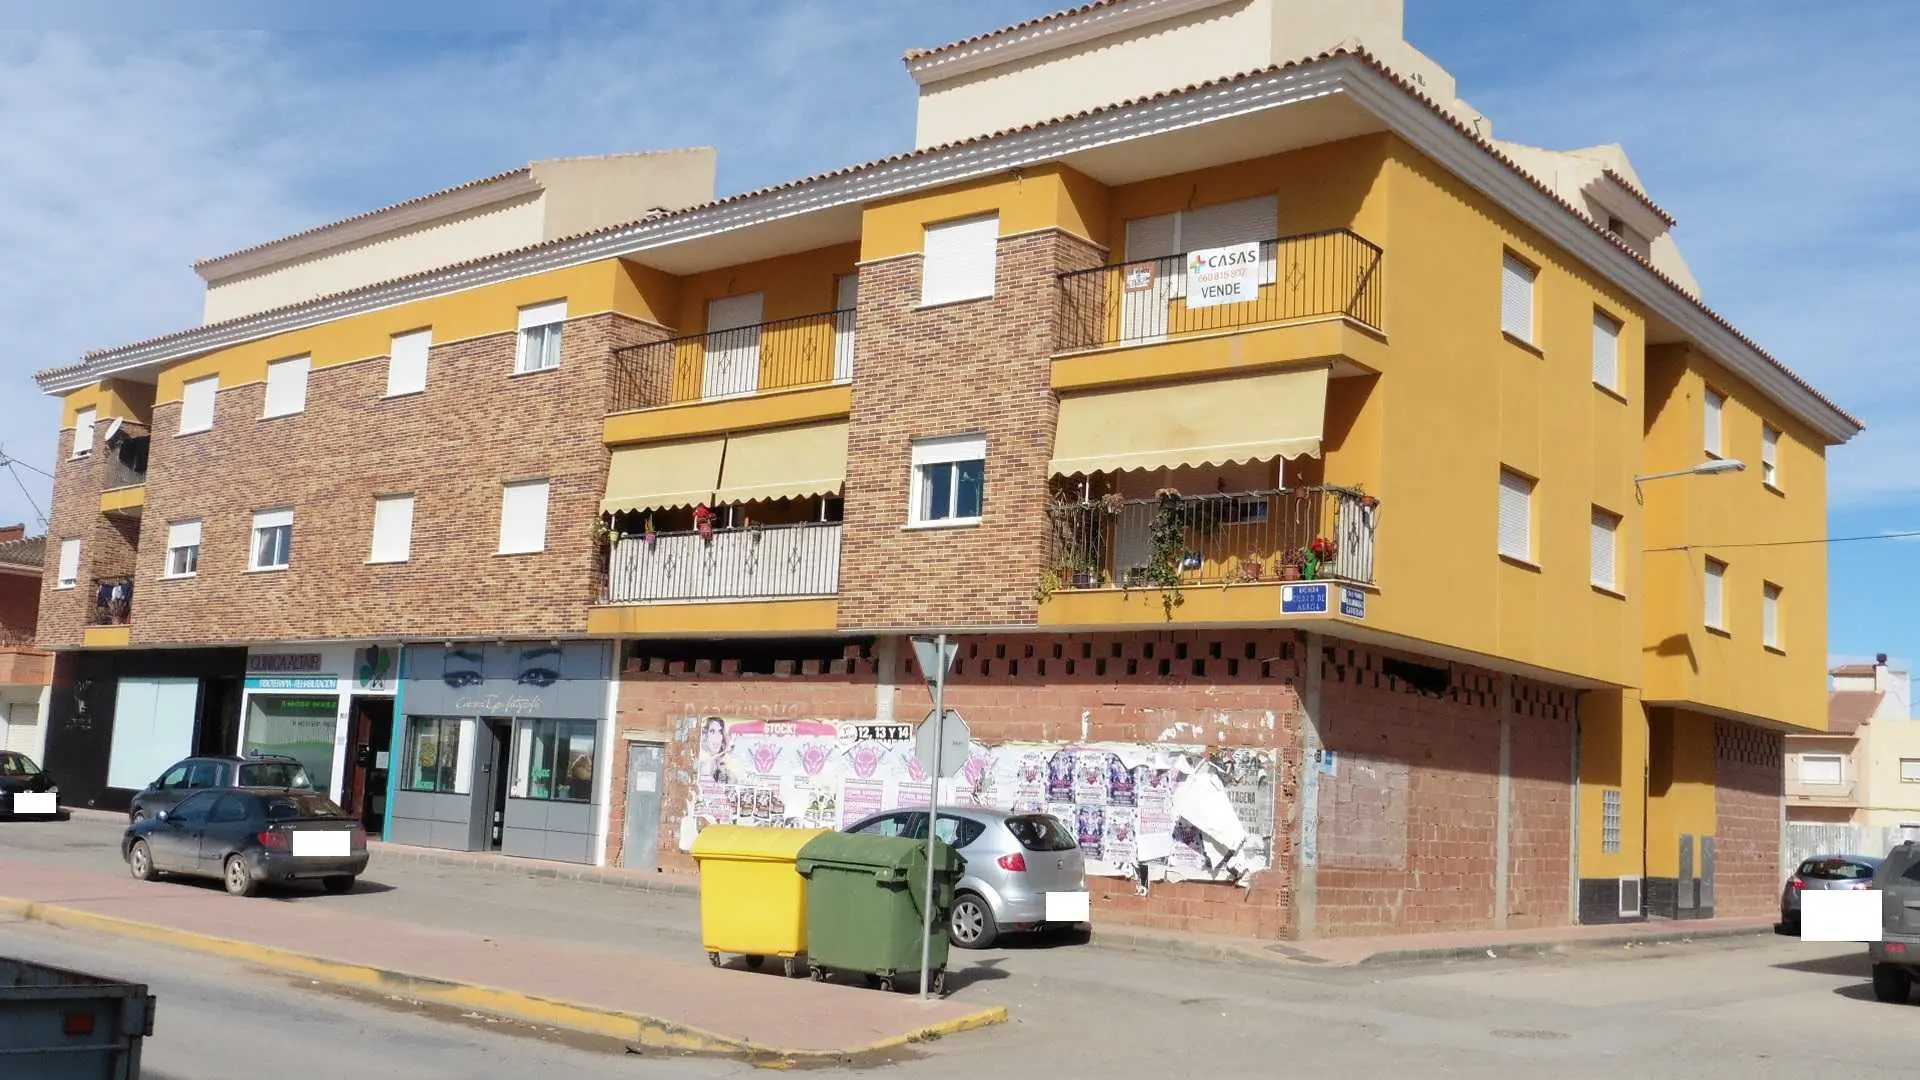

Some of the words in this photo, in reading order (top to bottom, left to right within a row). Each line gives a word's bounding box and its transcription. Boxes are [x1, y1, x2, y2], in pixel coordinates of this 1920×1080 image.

[1208, 250, 1256, 268] CASAS
[1201, 282, 1241, 299] VENDE
[875, 726, 886, 739] 13
[888, 726, 896, 738] Y
[898, 726, 909, 739] 14
